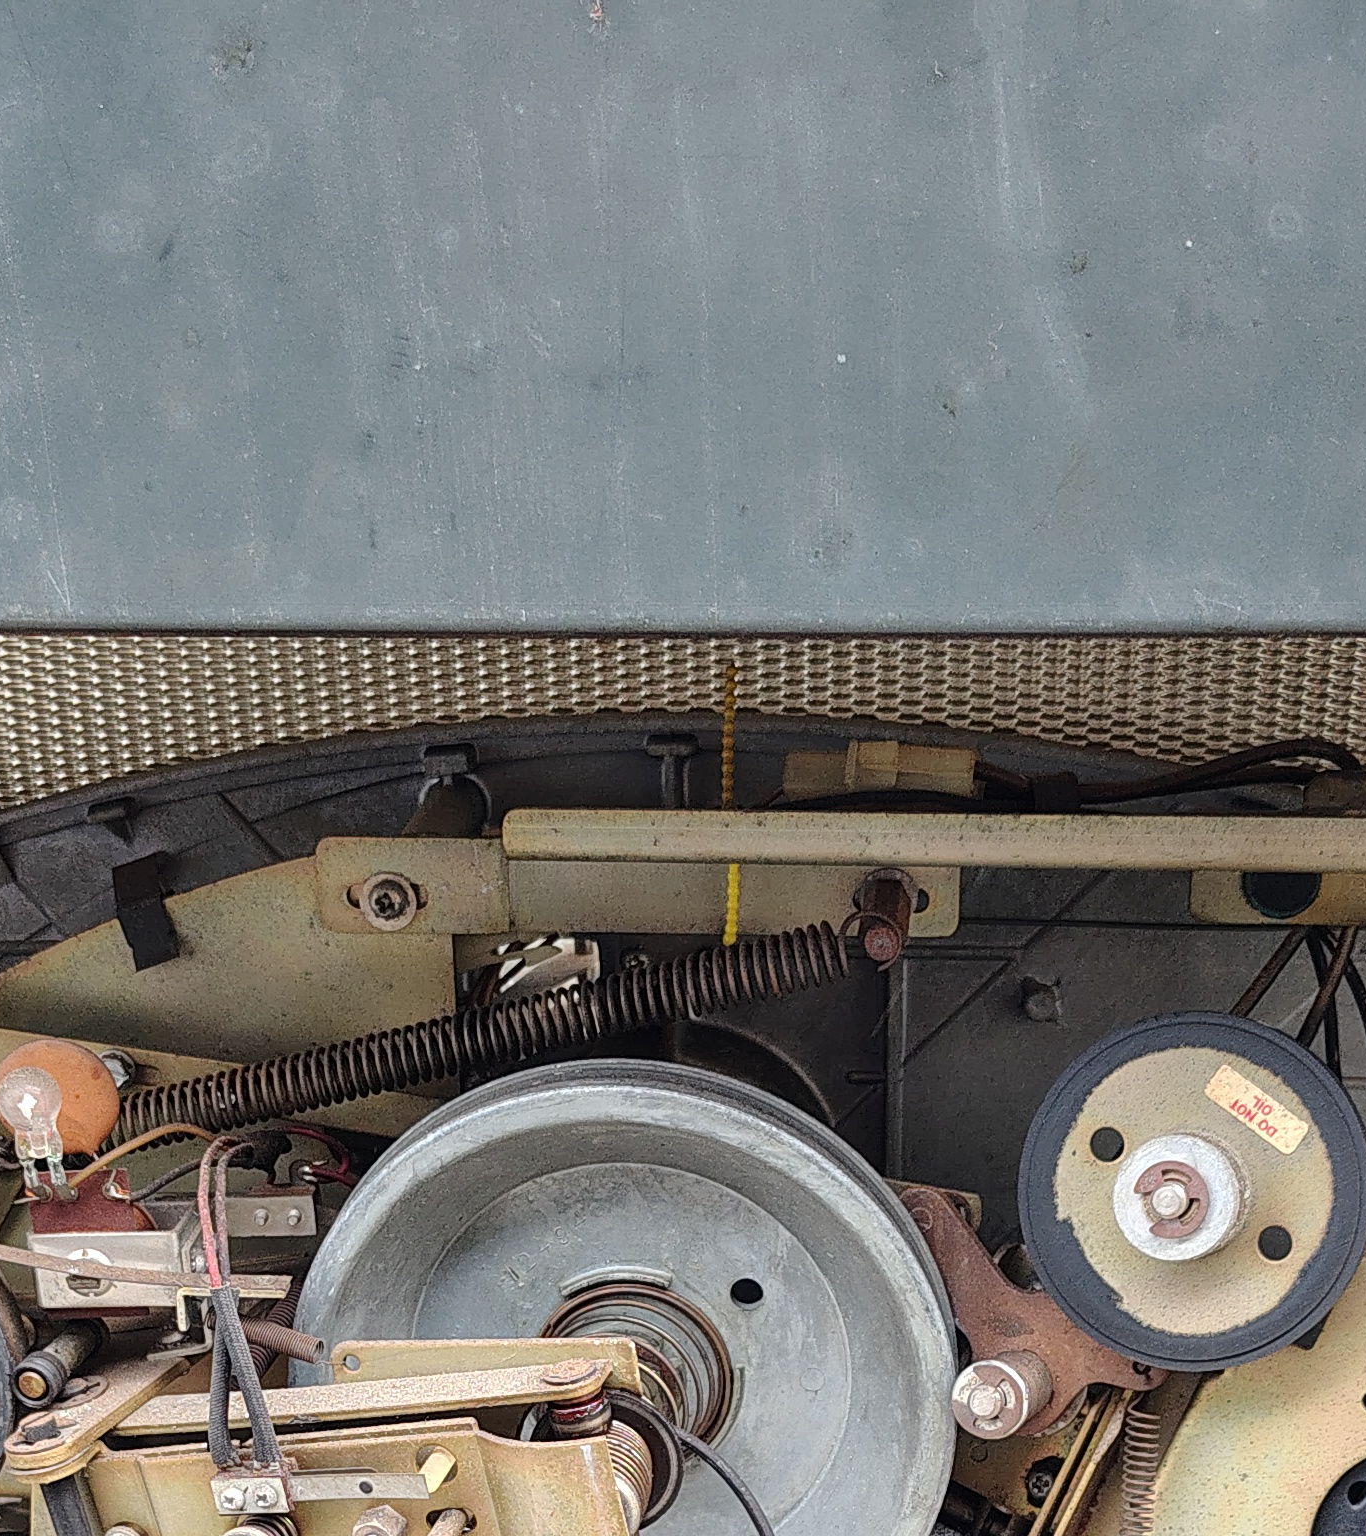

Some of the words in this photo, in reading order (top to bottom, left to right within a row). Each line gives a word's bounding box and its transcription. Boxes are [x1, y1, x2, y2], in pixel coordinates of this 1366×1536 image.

[1229, 1099, 1258, 1122] NOT
[1253, 1095, 1273, 1116] OIL
[1257, 1120, 1278, 1138] DO
